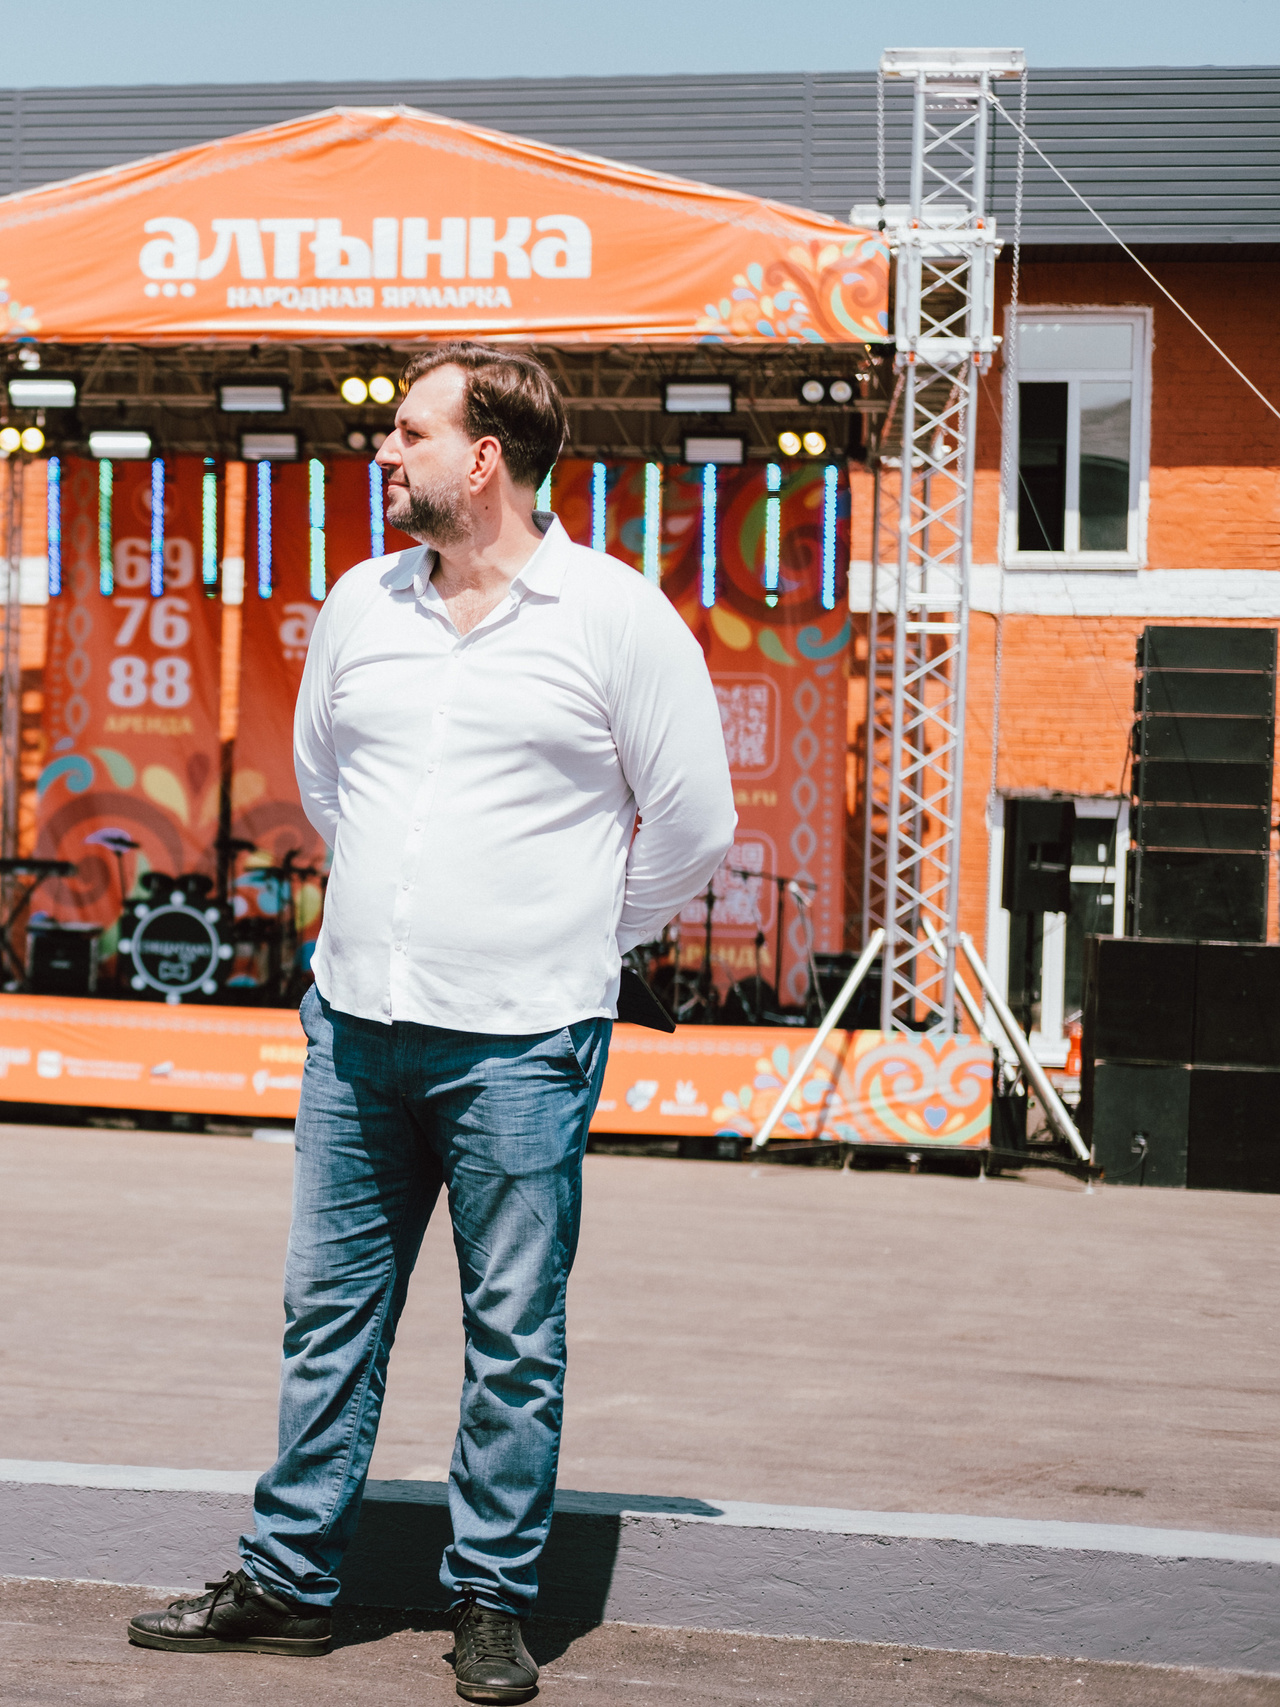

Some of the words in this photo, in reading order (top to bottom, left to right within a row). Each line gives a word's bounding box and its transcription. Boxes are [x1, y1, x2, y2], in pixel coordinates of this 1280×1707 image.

[226, 286, 375, 312] НАРОДНАЯ
[381, 286, 513, 309] ЯРМАРКА
[113, 537, 195, 589] 69
[113, 597, 191, 649] 76
[107, 655, 192, 709] 88
